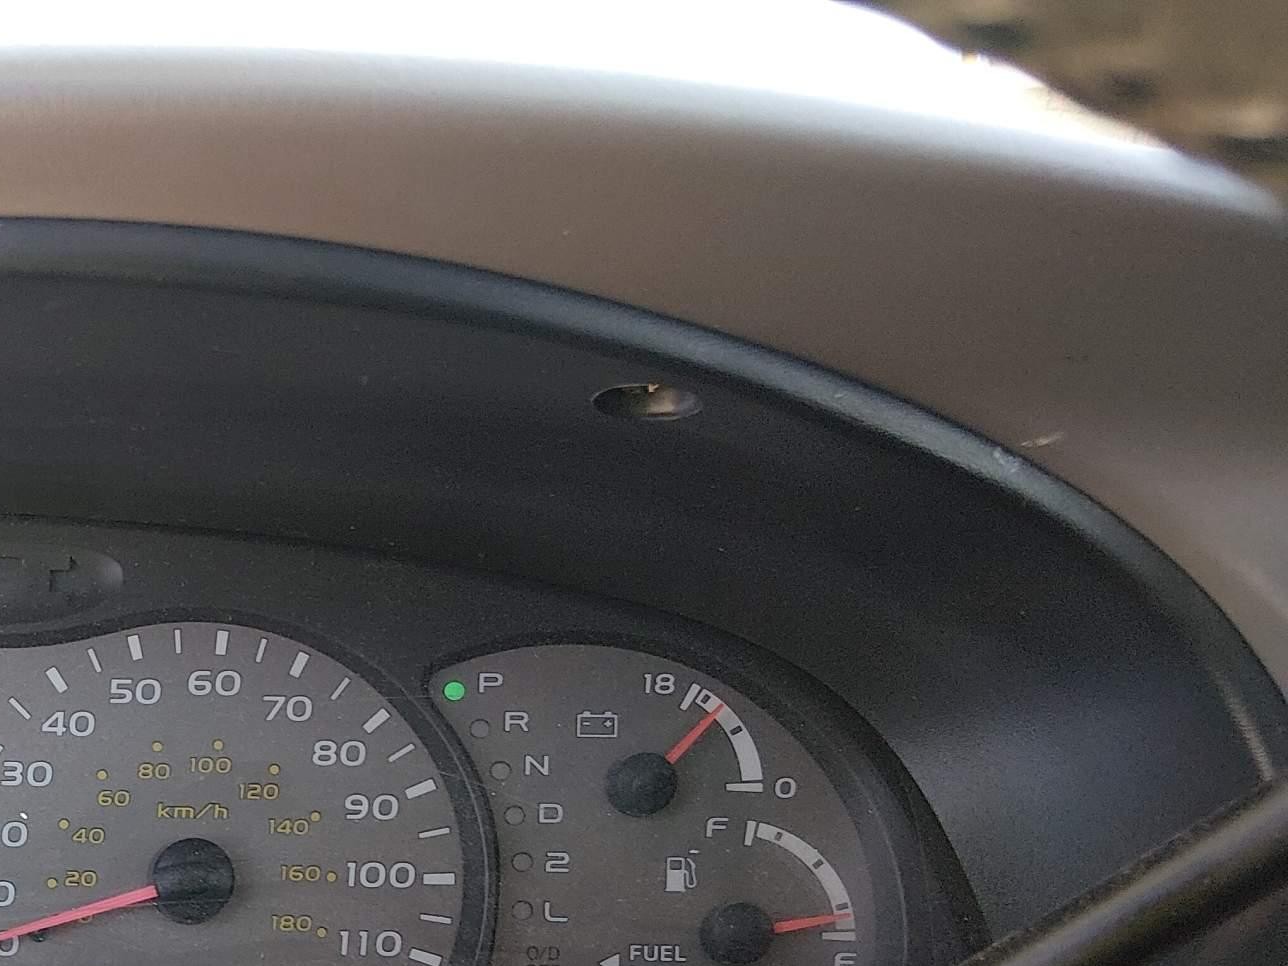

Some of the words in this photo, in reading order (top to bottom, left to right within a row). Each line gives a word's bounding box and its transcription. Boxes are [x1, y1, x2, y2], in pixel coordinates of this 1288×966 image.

[110, 679, 161, 705] 50
[187, 671, 241, 696] 60
[477, 672, 504, 693] P
[643, 674, 675, 695] 18
[262, 695, 312, 722] 70
[41, 711, 95, 737] 40
[504, 711, 529, 732] R
[312, 740, 366, 766] 80
[0, 761, 53, 787] 30
[137, 763, 171, 780] 80
[189, 756, 232, 775] 100
[524, 755, 550, 777] N
[97, 789, 131, 807] 60
[239, 783, 279, 801] 120
[156, 802, 229, 821] km/h
[344, 794, 399, 821] 90
[538, 804, 564, 824] D
[72, 827, 105, 844] 40
[268, 818, 309, 836] 140
[706, 817, 729, 837] F
[545, 851, 570, 873] 2
[64, 871, 97, 887] 20
[280, 865, 321, 882] 160
[346, 862, 416, 889] 100
[544, 901, 569, 922] L
[271, 915, 312, 933] 180
[338, 930, 402, 957] 110
[526, 945, 561, 962] O/D
[629, 945, 686, 963] FUEL
